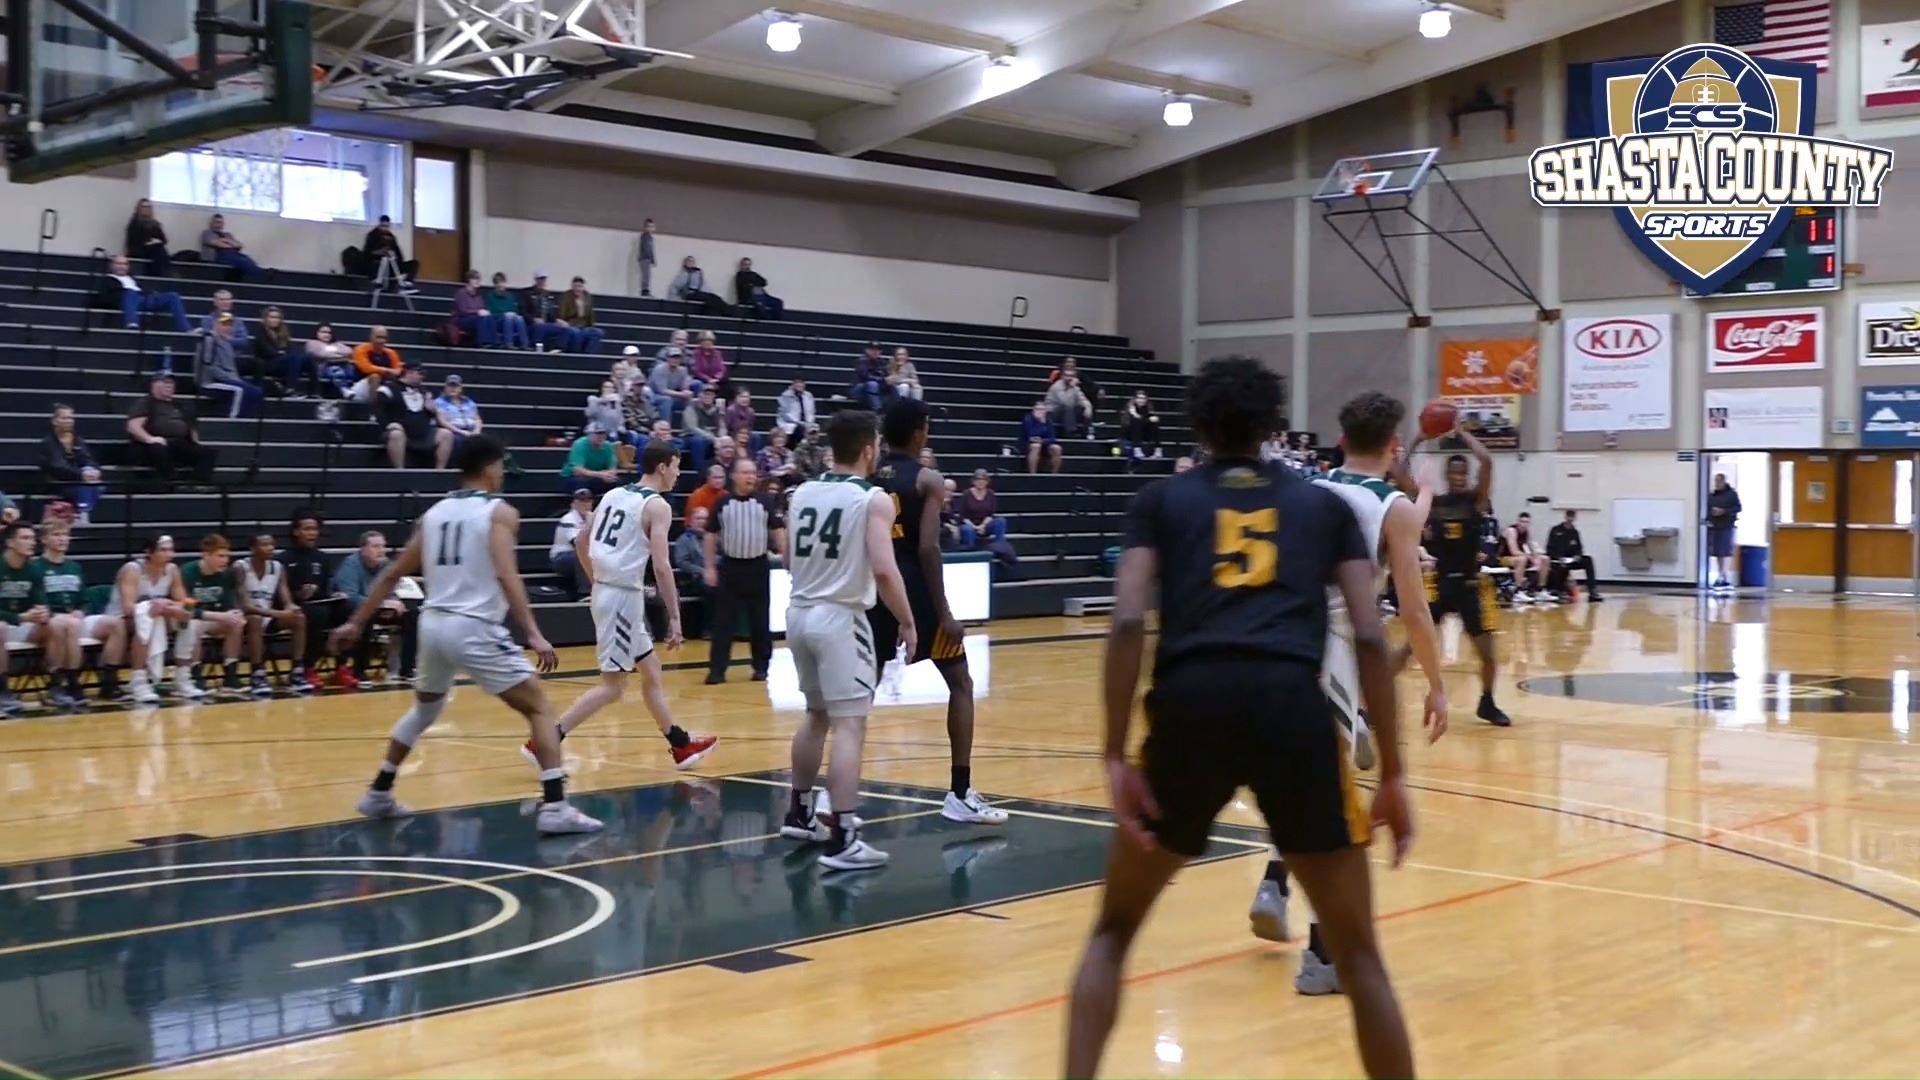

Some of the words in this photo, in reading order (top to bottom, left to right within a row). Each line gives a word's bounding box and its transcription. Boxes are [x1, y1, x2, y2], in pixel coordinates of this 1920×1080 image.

[1589, 329, 1648, 350] KIA
[436, 520, 464, 566] 11
[594, 506, 626, 547] 12
[795, 507, 842, 560] 24
[1213, 508, 1279, 588] 5
